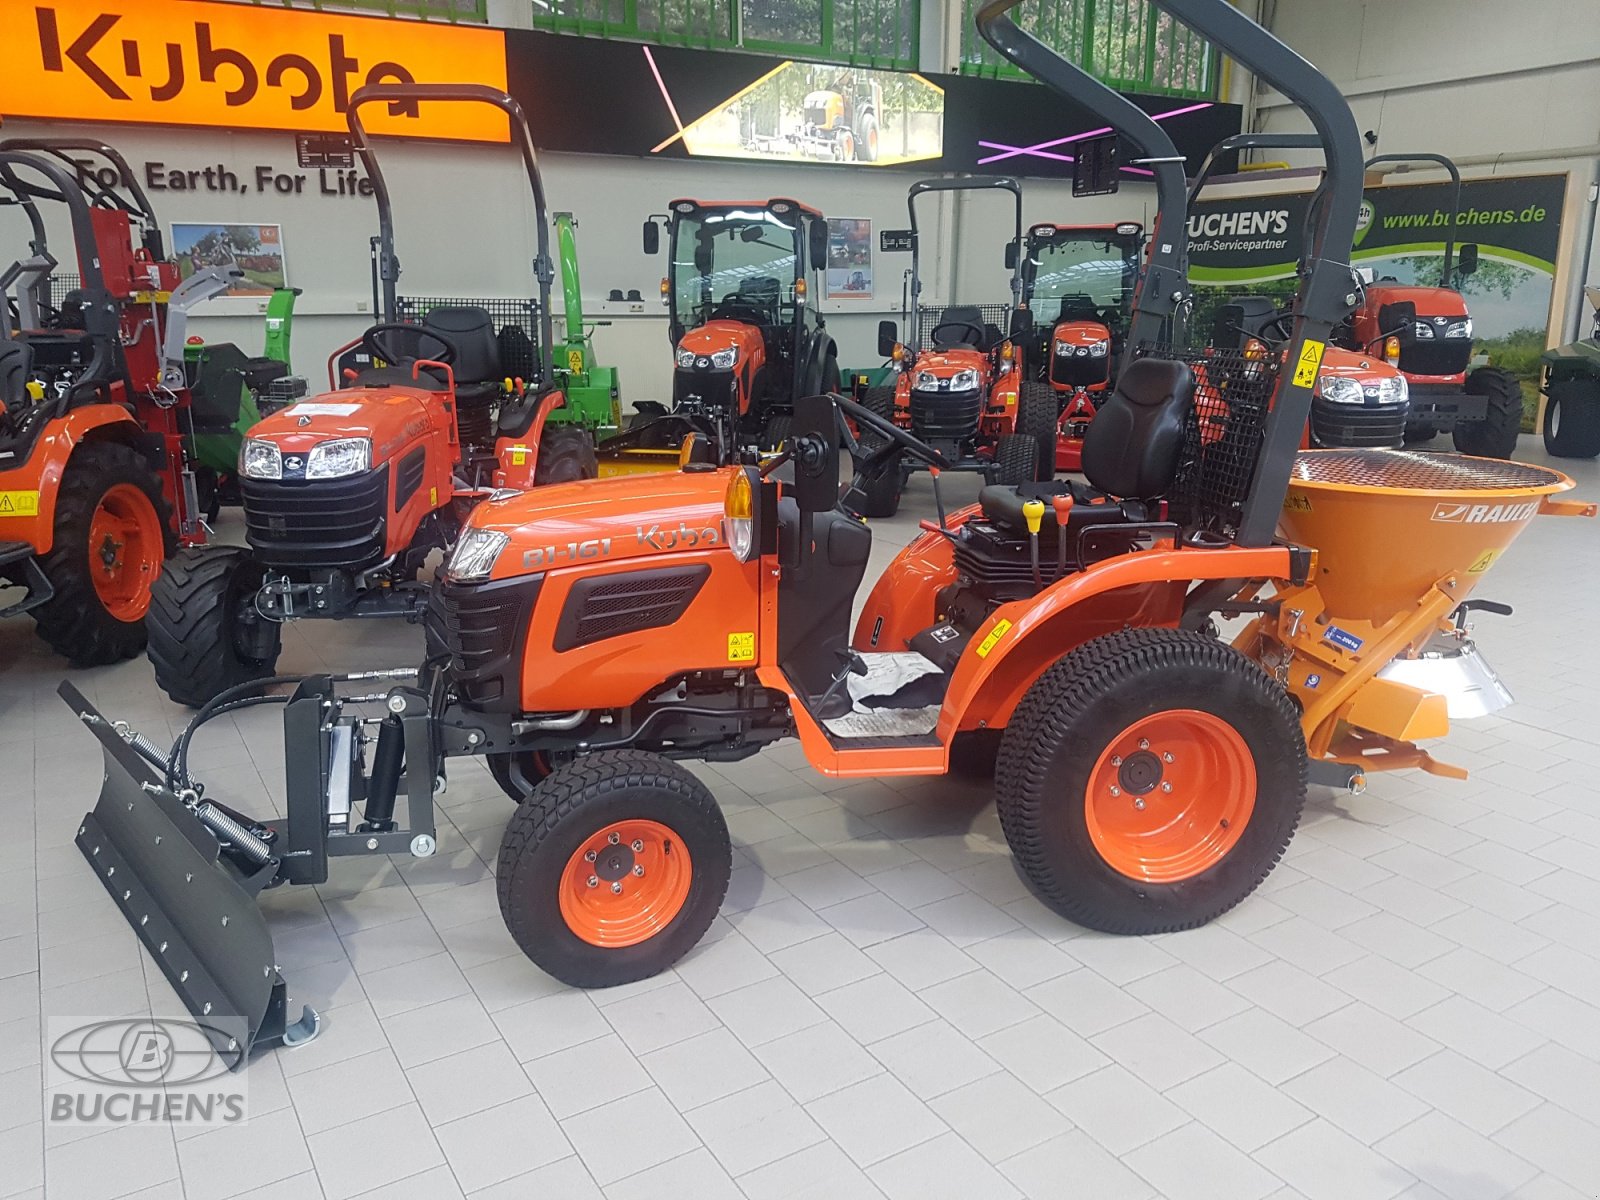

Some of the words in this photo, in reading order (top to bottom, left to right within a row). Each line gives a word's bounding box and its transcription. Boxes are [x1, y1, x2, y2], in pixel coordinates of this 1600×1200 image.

[35, 6, 420, 119] Kubota
[145, 161, 248, 194] Earth,
[255, 165, 306, 193] For
[319, 167, 375, 196] Life
[1187, 210, 1289, 238] UCHEN'S
[1186, 239, 1288, 252] Profi-Servicepartner
[522, 538, 612, 569] B1-161
